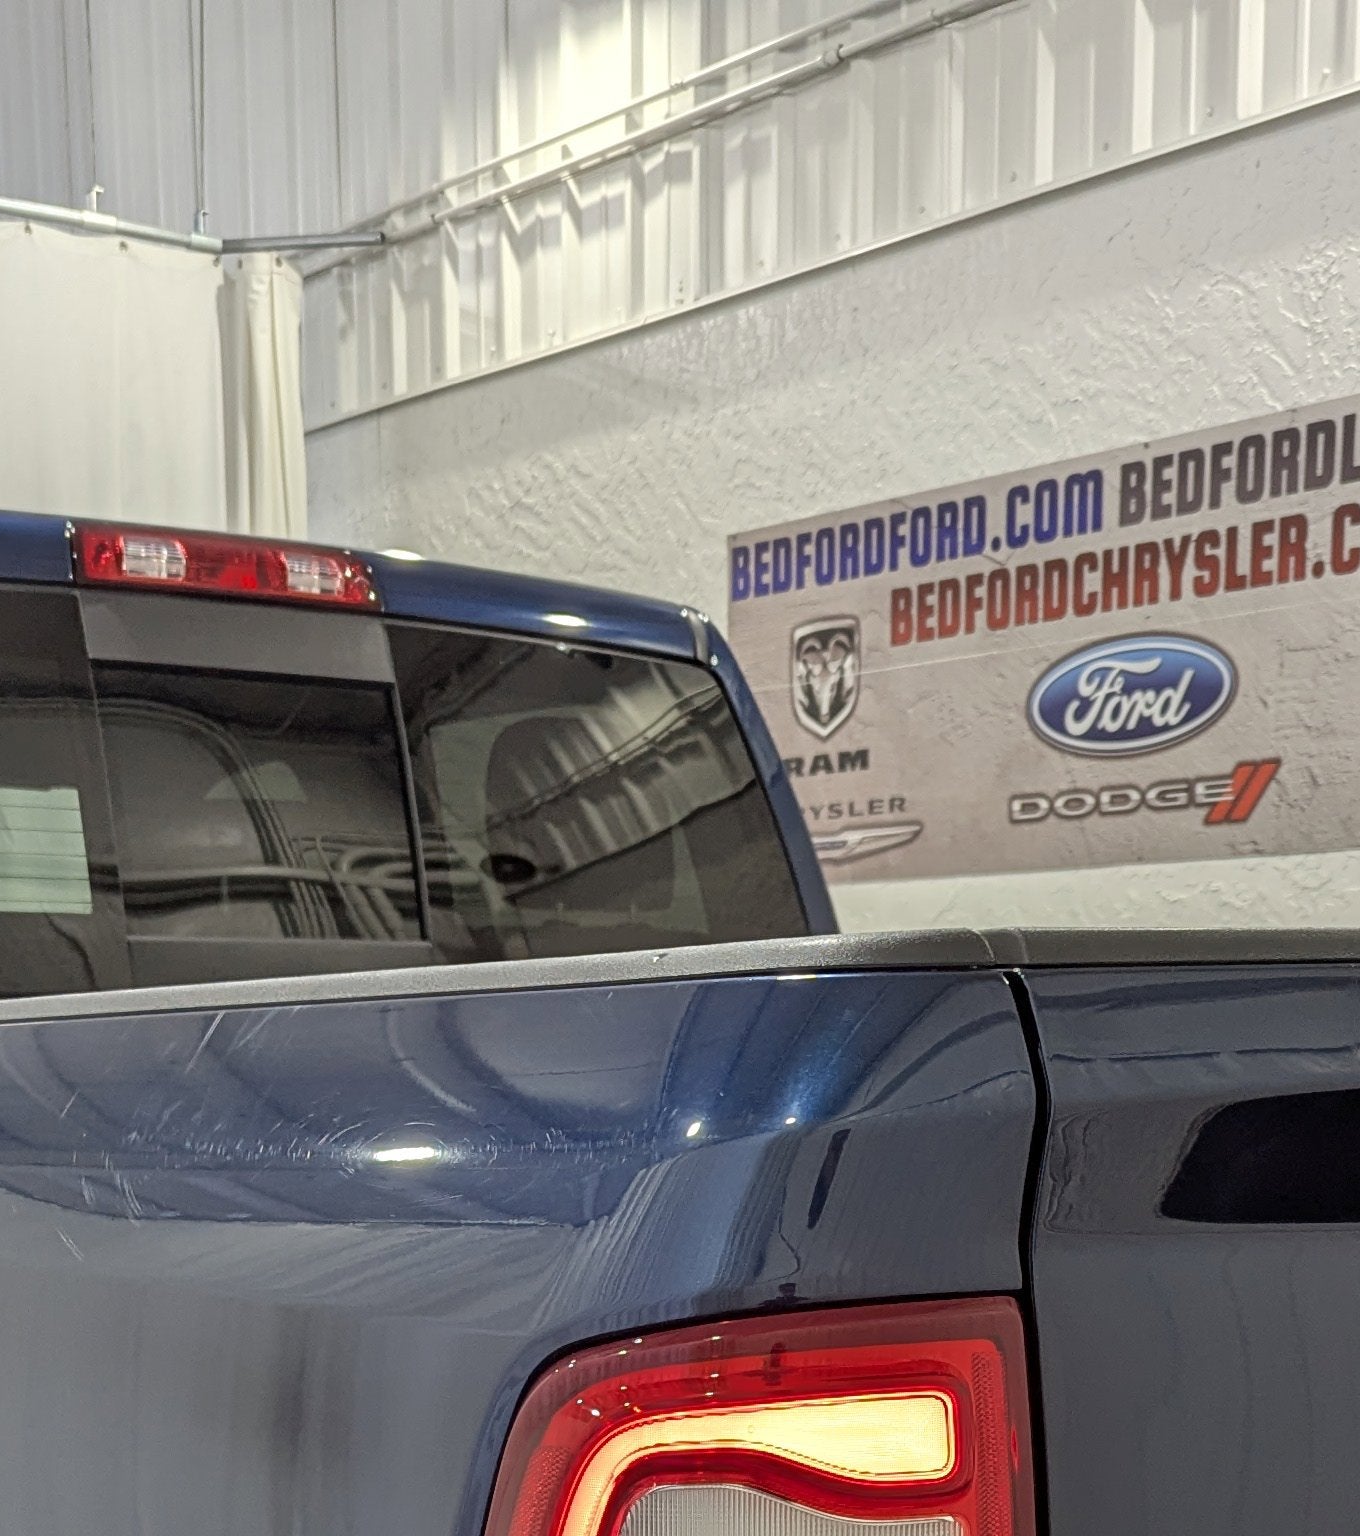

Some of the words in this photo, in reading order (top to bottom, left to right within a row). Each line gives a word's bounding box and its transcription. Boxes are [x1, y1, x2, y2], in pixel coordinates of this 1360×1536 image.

[731, 468, 1104, 602] BEDFORDFORD.COM
[1064, 657, 1195, 736] Ford
[783, 749, 870, 778] RAM
[801, 794, 907, 821] YSLER
[1008, 774, 1236, 824] DODGE
